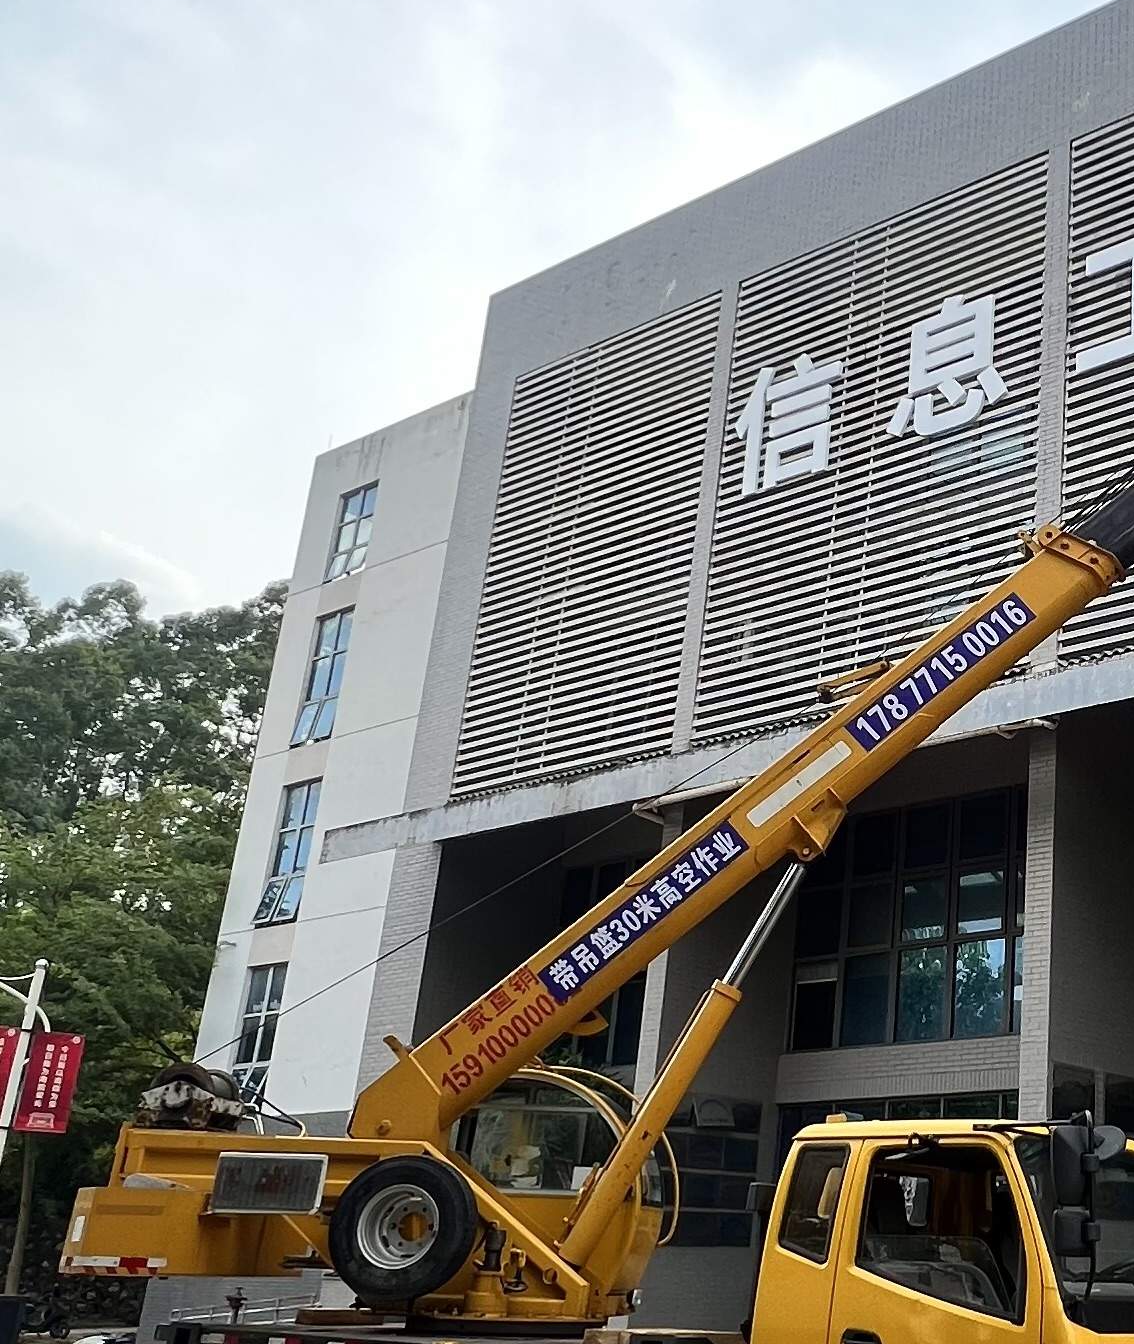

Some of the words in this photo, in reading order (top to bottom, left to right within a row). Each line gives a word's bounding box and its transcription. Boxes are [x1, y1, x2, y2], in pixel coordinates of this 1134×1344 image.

[856, 693, 909, 742] 178
[899, 645, 968, 706] 7715
[962, 599, 1028, 658] 0016
[548, 830, 742, 991] 带吊篮30米高空作业
[437, 965, 540, 1056] 厂家直销
[441, 989, 580, 1096] 159100000
